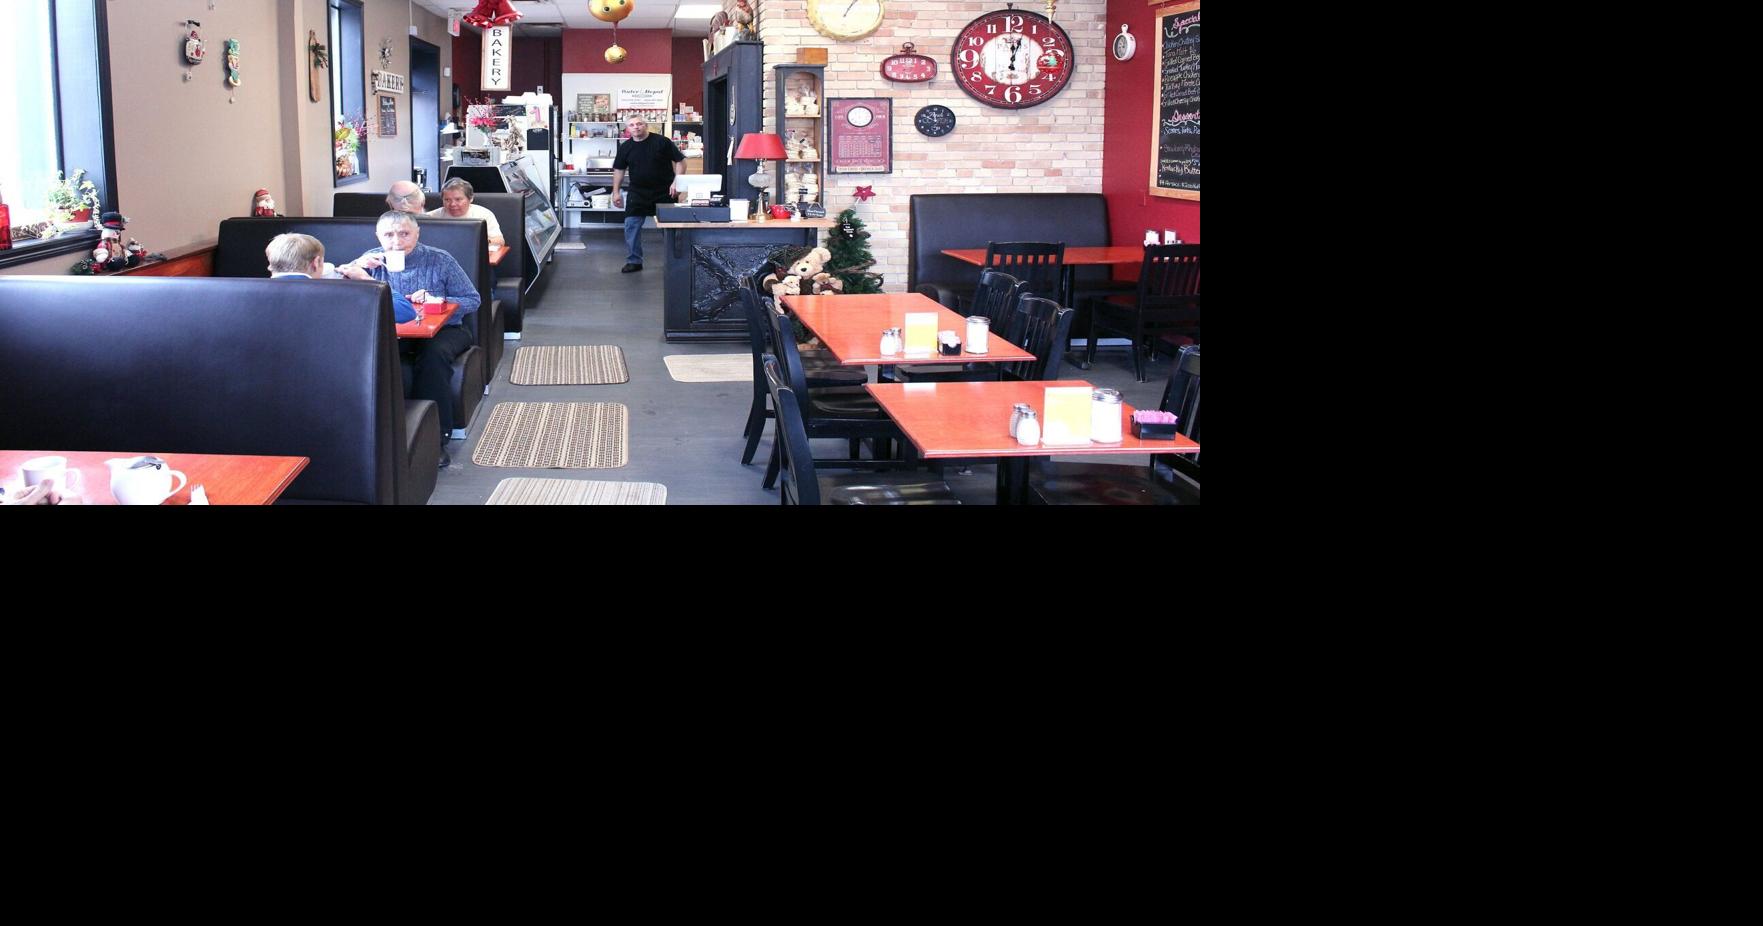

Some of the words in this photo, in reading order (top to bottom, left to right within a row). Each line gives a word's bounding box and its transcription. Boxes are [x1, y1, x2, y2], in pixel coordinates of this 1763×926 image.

[986, 24, 997, 34] 11
[1004, 15, 1024, 33] 12
[1031, 25, 1037, 34] 1
[968, 36, 984, 47] 10
[1042, 37, 1056, 47] 2
[492, 29, 502, 86] BAKERY
[959, 49, 980, 70] 9
[970, 72, 983, 82] 8
[1041, 73, 1057, 82] 4
[984, 84, 997, 95] 7
[1004, 86, 1022, 103] 6
[1028, 84, 1042, 95] 5
